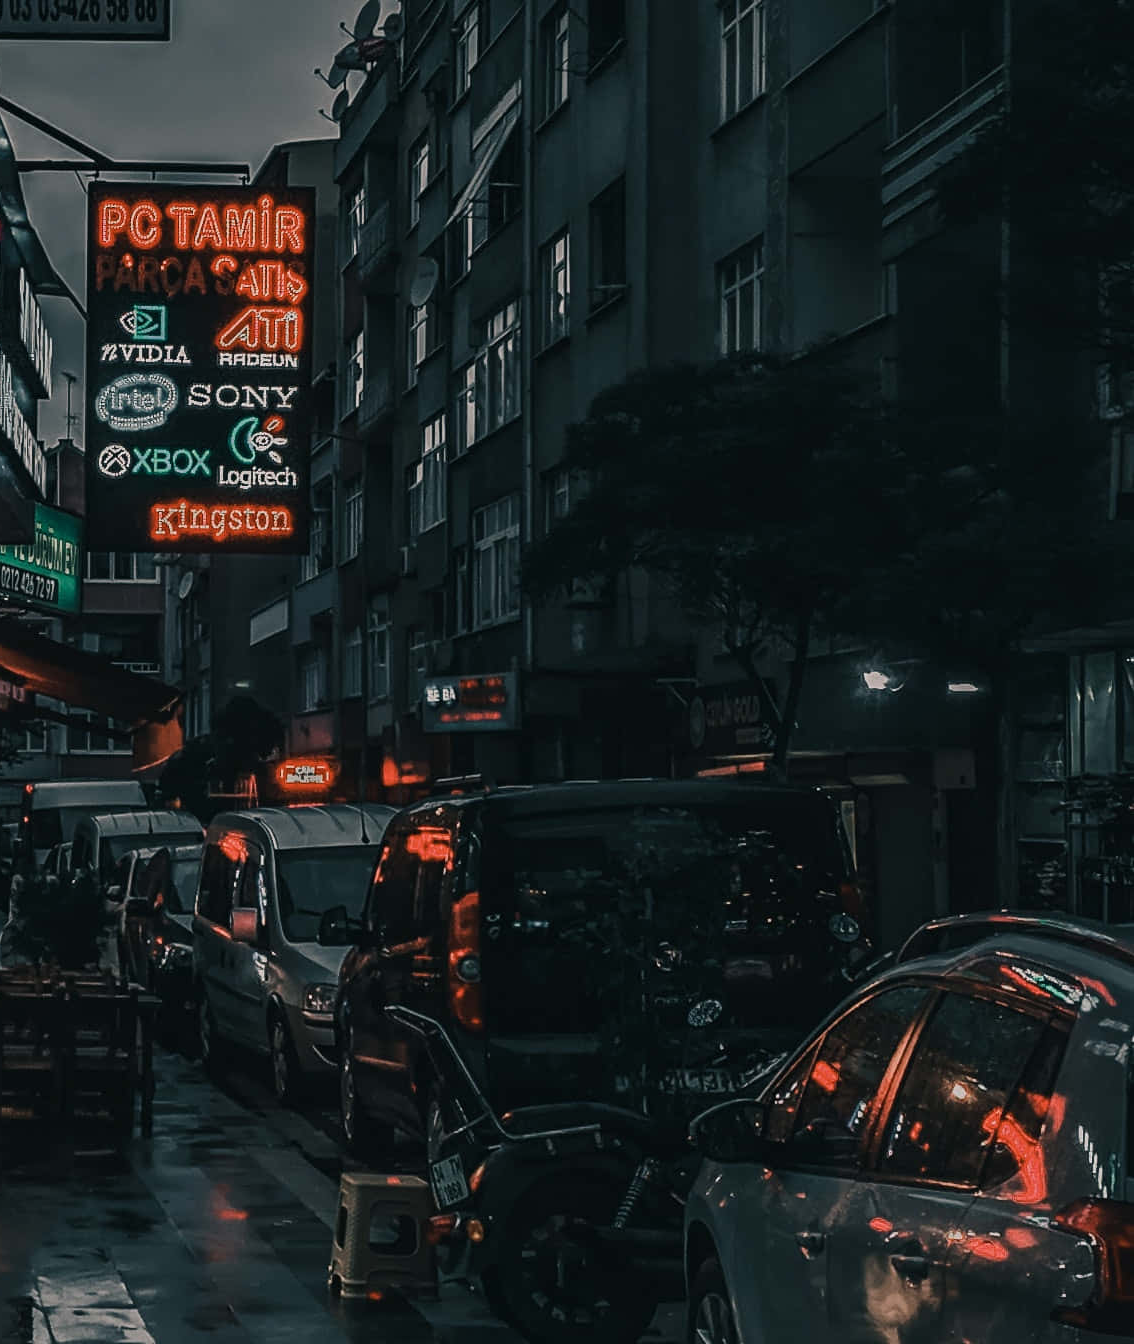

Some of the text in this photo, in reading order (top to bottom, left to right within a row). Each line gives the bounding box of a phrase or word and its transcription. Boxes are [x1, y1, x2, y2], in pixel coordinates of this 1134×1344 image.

[101, 197, 304, 251] PC TAMİR
[217, 308, 303, 351] ATI
[187, 384, 298, 409] SONY
[132, 448, 212, 477] XBOX
[217, 464, 298, 490] Logitech
[153, 497, 292, 539] Kingston
[1, 566, 19, 592] 0212
